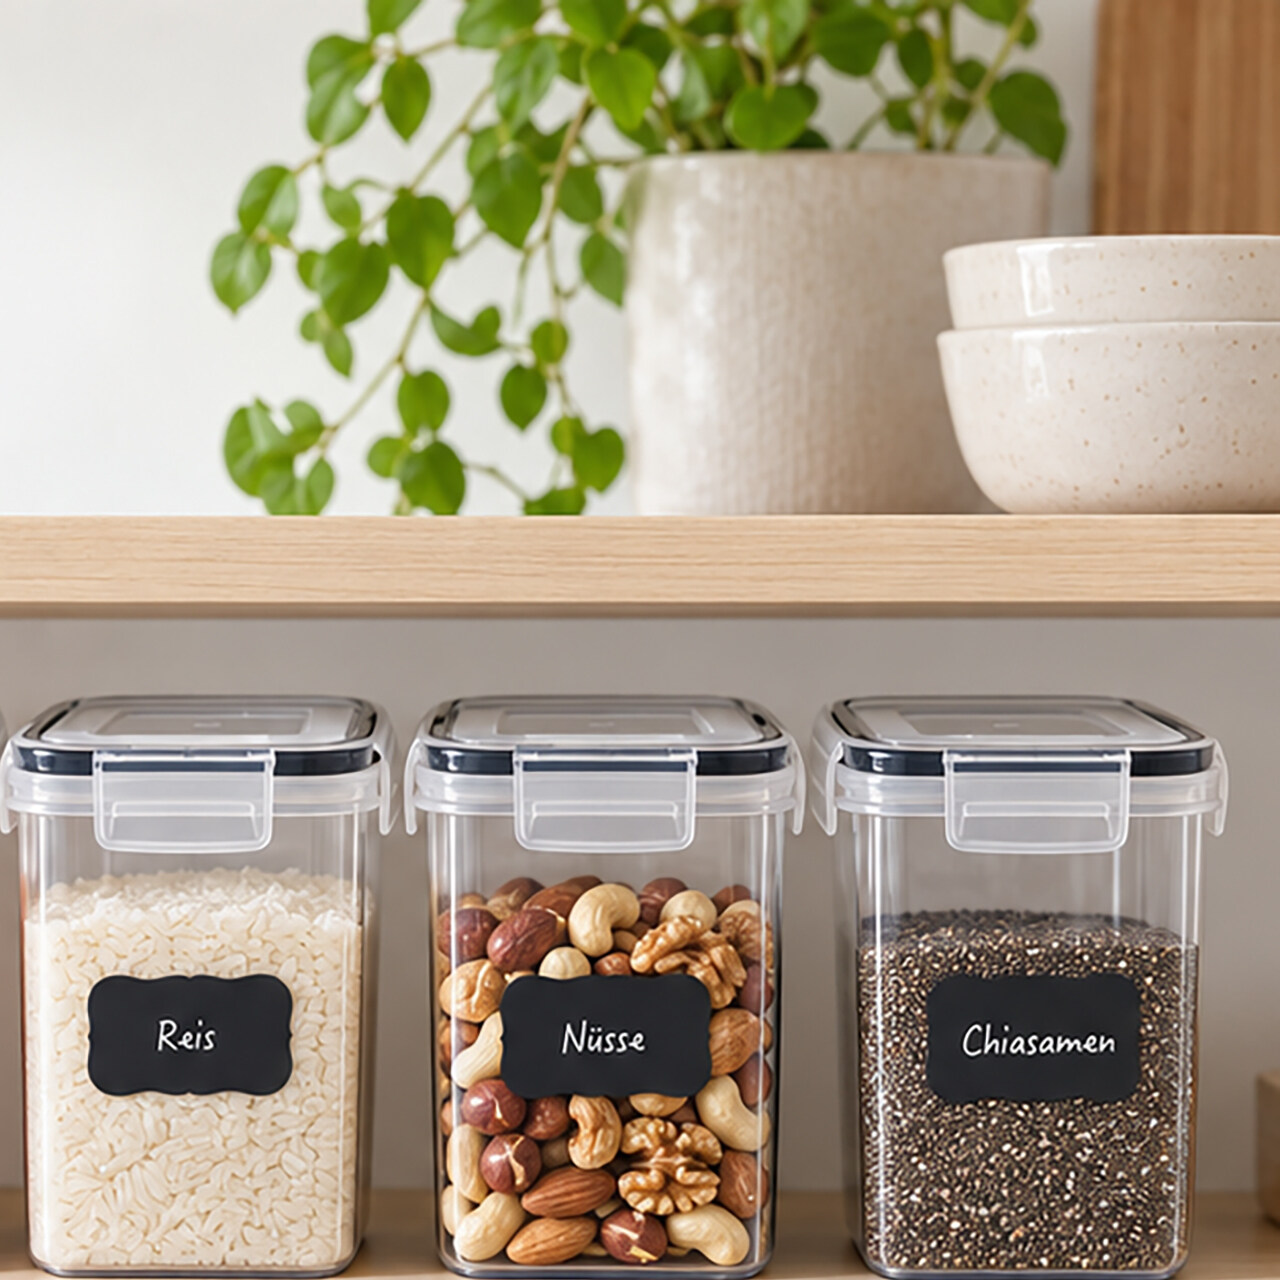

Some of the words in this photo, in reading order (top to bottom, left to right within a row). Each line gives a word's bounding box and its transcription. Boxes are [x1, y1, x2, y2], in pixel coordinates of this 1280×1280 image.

[157, 1019, 216, 1052] Reis
[561, 1019, 646, 1055] Nüsse
[961, 1023, 1116, 1058] Chiasamen
